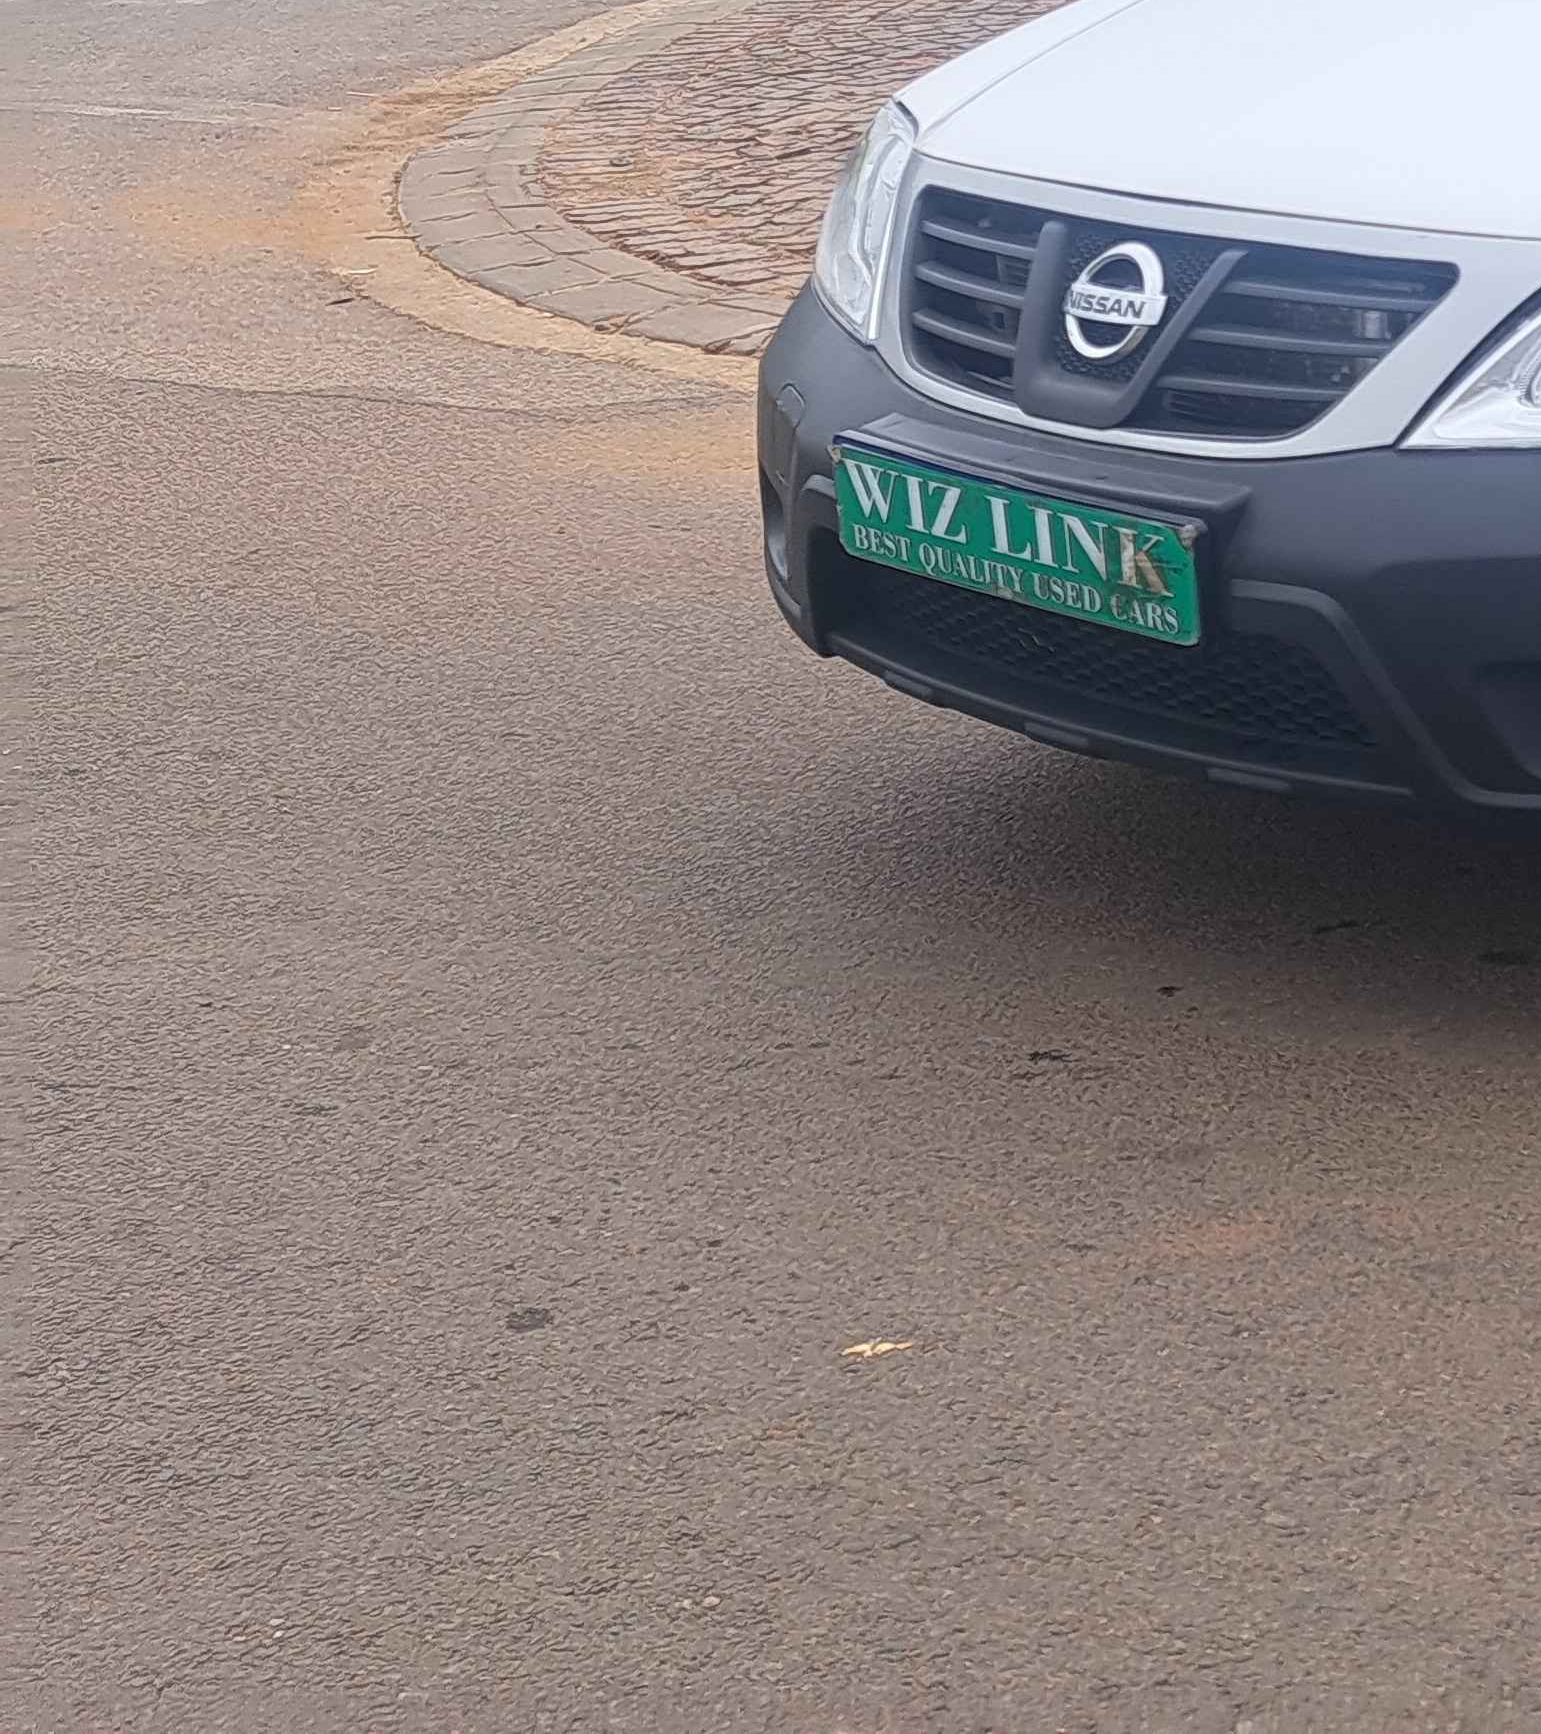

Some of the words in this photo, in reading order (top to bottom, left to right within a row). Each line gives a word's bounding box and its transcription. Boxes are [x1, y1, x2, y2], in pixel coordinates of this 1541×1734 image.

[1070, 291, 1147, 319] NISSAN
[843, 457, 968, 544] WIZ
[984, 495, 1175, 598] LINK
[853, 524, 911, 562] BEST
[919, 543, 1026, 595] QUALITY
[1033, 572, 1103, 613] USED
[1110, 594, 1180, 635] CARS
